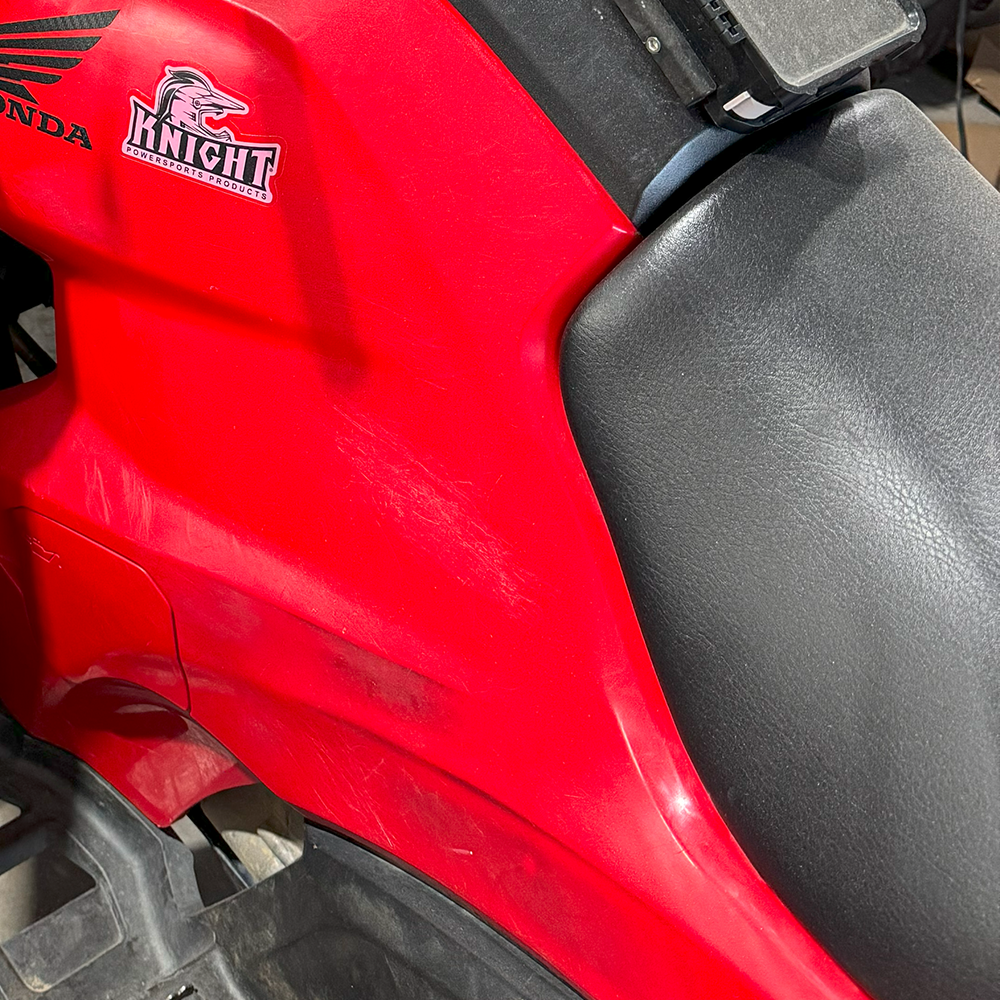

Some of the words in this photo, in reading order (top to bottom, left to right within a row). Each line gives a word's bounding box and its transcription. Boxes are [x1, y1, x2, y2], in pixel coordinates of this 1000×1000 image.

[126, 145, 204, 179] POWERSPORTS
[208, 174, 268, 201] PRODUCTS
[132, 108, 275, 190] KNIGHT
